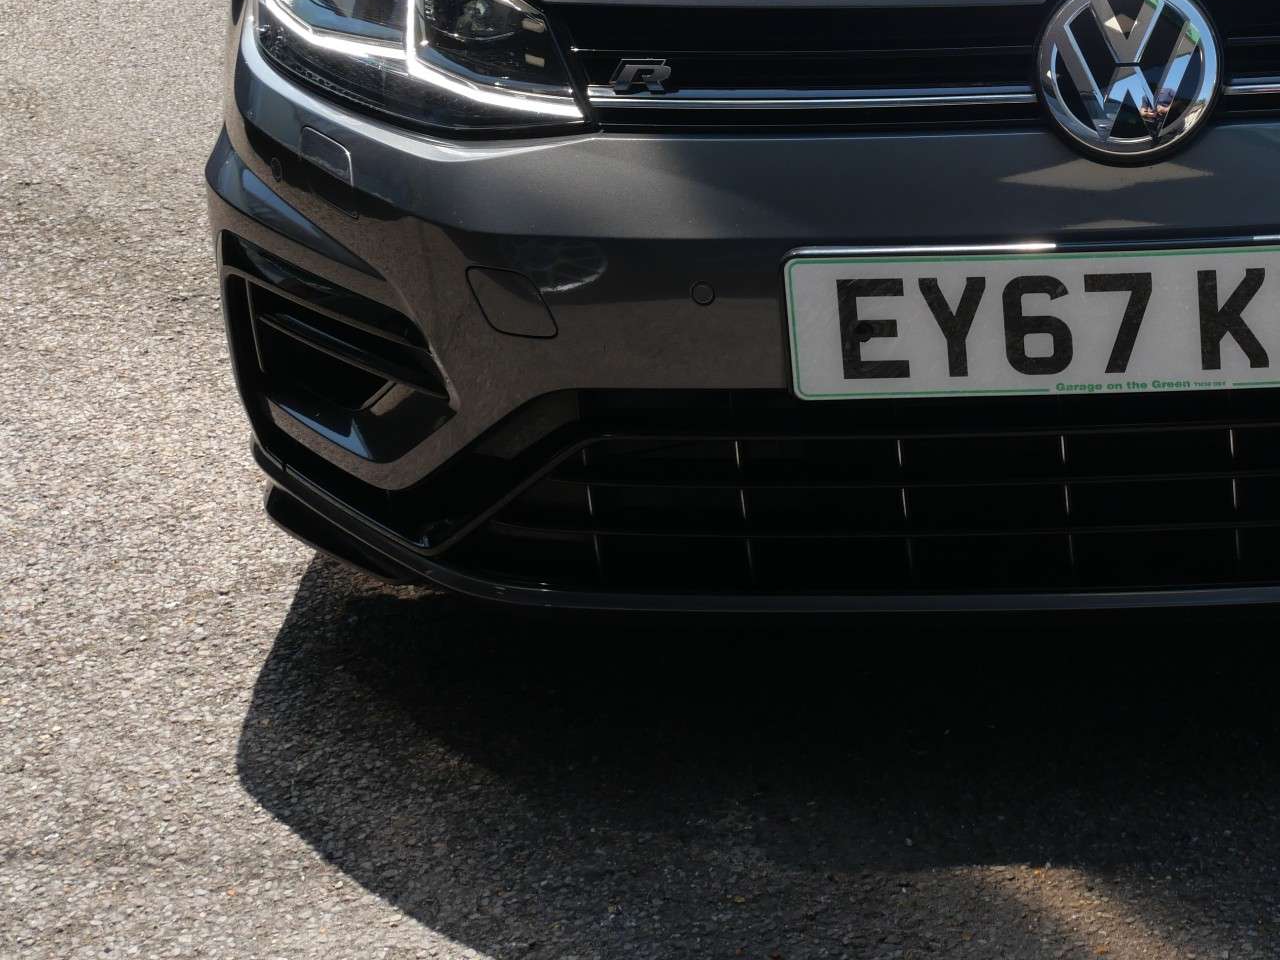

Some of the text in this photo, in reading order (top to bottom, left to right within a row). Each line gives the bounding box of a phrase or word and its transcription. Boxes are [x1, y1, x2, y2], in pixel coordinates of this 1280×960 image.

[612, 58, 673, 94] R
[836, 272, 1153, 379] EY67
[1056, 382, 1101, 392] Garage
[1106, 382, 1123, 391] on
[1126, 380, 1148, 390] the
[1151, 380, 1191, 389] Green
